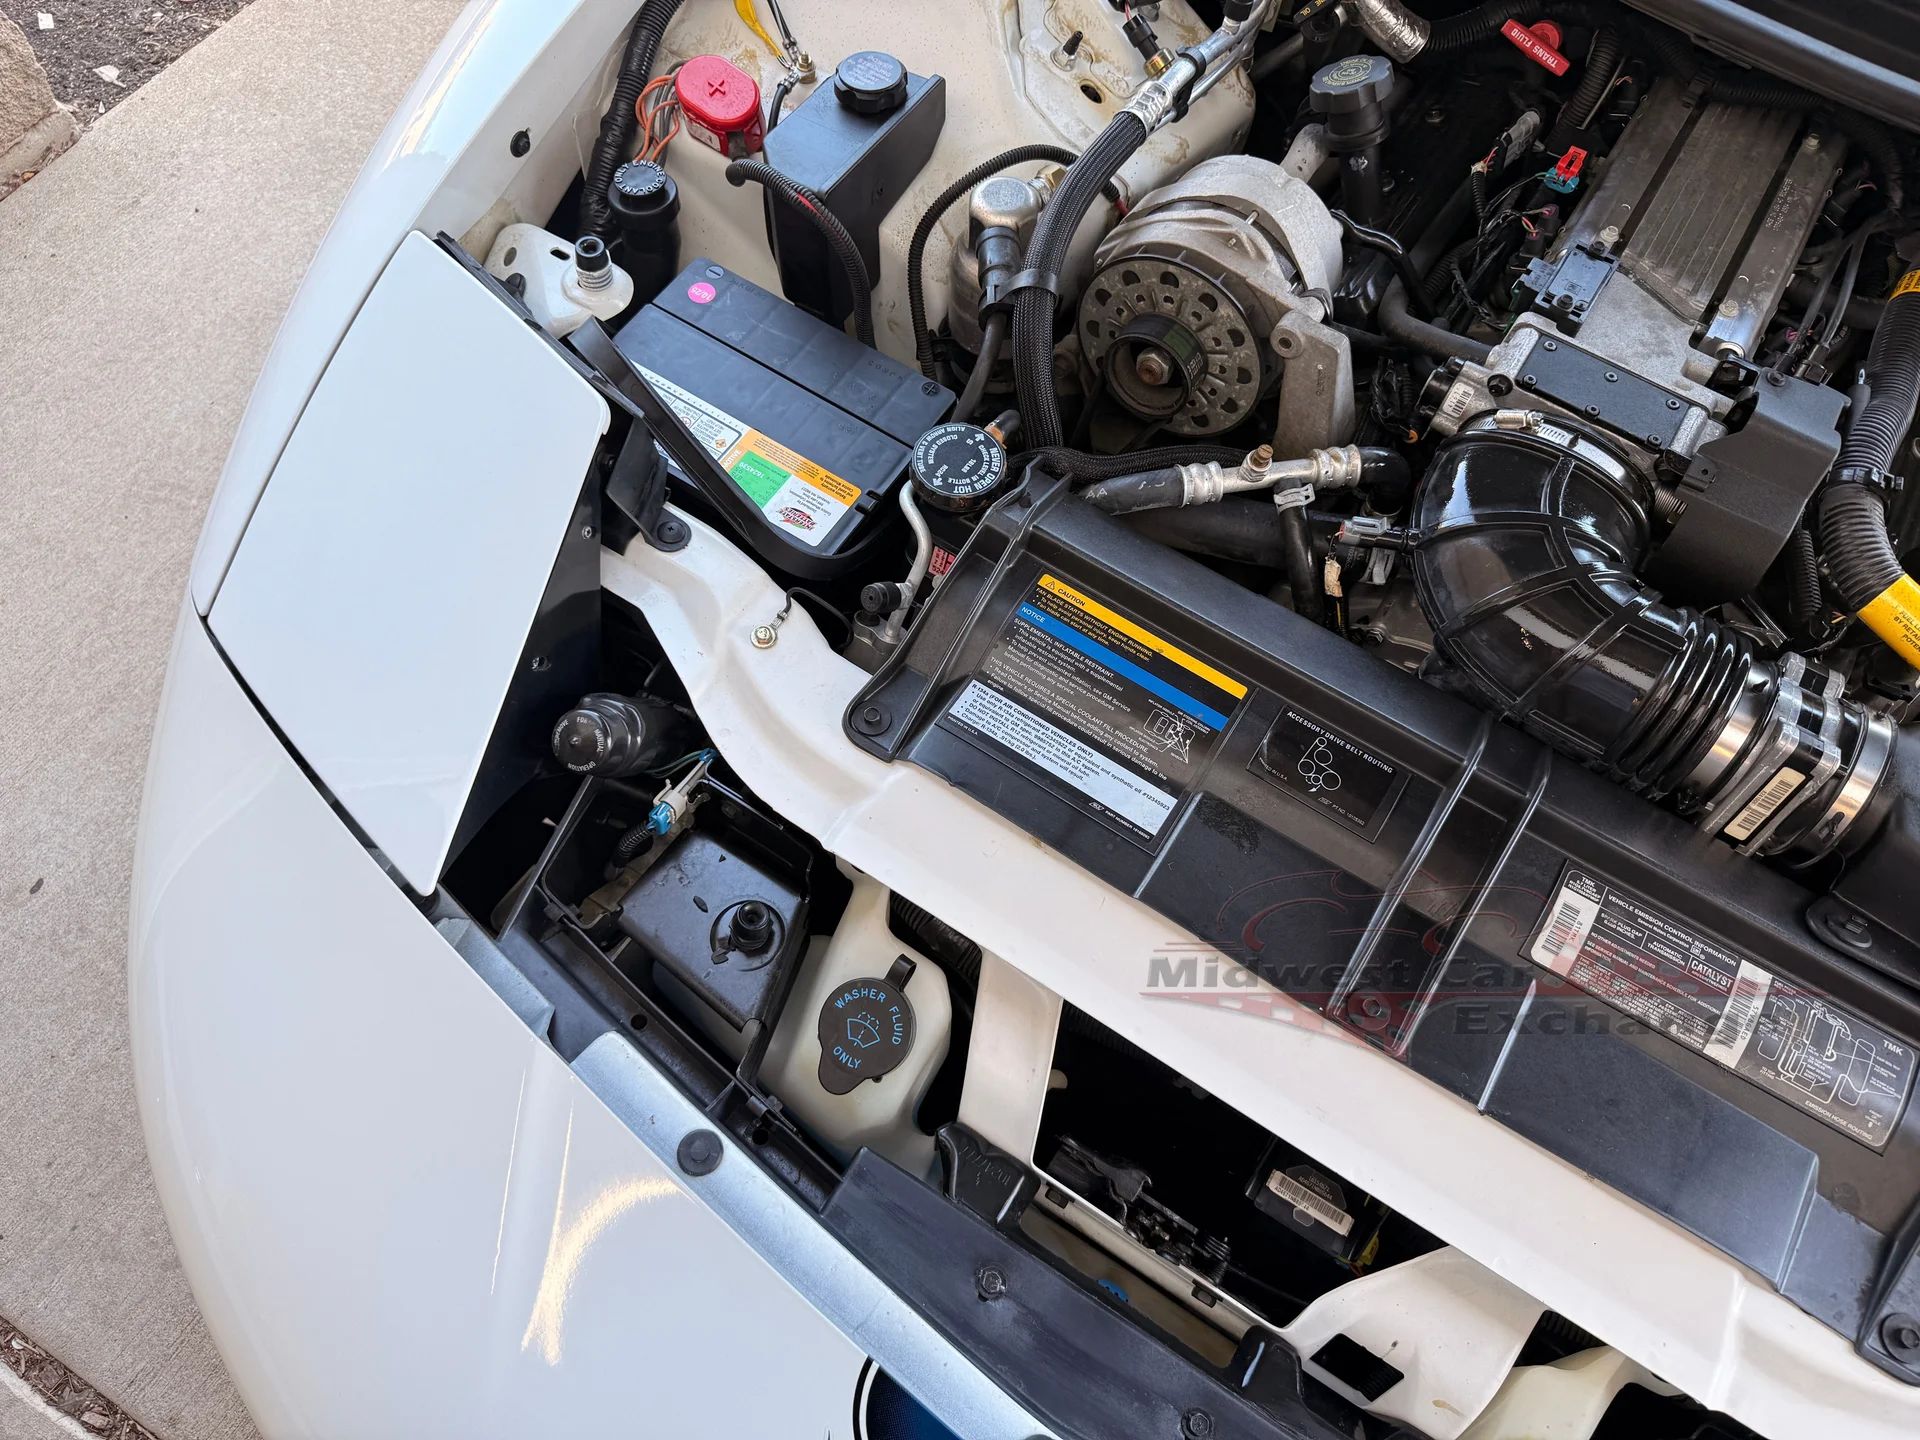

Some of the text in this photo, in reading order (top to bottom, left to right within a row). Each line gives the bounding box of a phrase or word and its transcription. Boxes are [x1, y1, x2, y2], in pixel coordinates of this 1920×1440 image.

[1511, 28, 1558, 68] TRANS FLUID
[858, 59, 892, 77] STEERING
[868, 56, 894, 70] POWER
[615, 160, 664, 194] ENGINE COOLANT ONLY
[691, 286, 711, 300] 10/25
[917, 446, 925, 458] VENT
[928, 434, 958, 464] CLOSED SYSTEM
[978, 444, 990, 460] CHECK
[989, 448, 1000, 472] NEVER
[738, 461, 765, 478] 1624539
[917, 459, 926, 474] TUBE
[978, 462, 989, 476] LEVEL
[820, 482, 847, 499] Return warranty
[823, 478, 839, 489] batteries
[824, 474, 854, 492] Costco Wholesale
[974, 473, 995, 490] OPEN
[776, 508, 814, 531] INTERSTATE
[783, 506, 815, 526] BATTERIES
[1056, 587, 1086, 606] CAUTION
[1021, 606, 1045, 623] NOTICE
[1035, 587, 1154, 657] FAN BLADE STARTS WITHOUT ENGINE RUNNING.
[1036, 601, 1047, 610] Fan
[1046, 607, 1061, 618] blade
[1060, 615, 1070, 623] can
[1069, 620, 1082, 630] start
[1087, 631, 1097, 639] any
[1096, 636, 1110, 646] time.
[1894, 616, 1903, 625] BY
[1899, 611, 1915, 625] FUEL
[1045, 600, 1058, 610] help
[1056, 607, 1072, 618] avoid
[1070, 615, 1093, 630] personal
[1091, 627, 1108, 639] injury,
[1106, 635, 1120, 646] keep
[1119, 643, 1136, 655] hands
[1135, 651, 1150, 663] clear.
[1013, 618, 1114, 678] SUPPLEMENTAL INFLATABLE RESTRAINT.
[1017, 628, 1029, 637] This
[1028, 634, 1047, 647] vehicle
[1051, 647, 1075, 663] equipped
[1073, 660, 1086, 670] with
[1089, 669, 1123, 692] supplemental
[1006, 645, 1115, 711] Manual for diagnostic and service procedures
[1016, 643, 1029, 653] help
[1027, 649, 1047, 663] prevent
[1046, 660, 1072, 678] unwanted
[1070, 674, 1093, 690] inflation,
[1092, 687, 1102, 696] see
[1101, 692, 1112, 701] GM
[1111, 698, 1131, 713] Service
[989, 656, 1003, 667] THIS
[1001, 663, 1024, 679] VEHICLE
[1023, 676, 1051, 695] REQUIRES
[1054, 695, 1078, 711] SPECIAL
[1076, 707, 1103, 726] COOLANT
[1102, 723, 1115, 733] FILL
[1114, 730, 1150, 754] PROCEDURE.
[971, 683, 1094, 758] R-134a (FOR AIR CONDITIONED VEHICLES ONLY)
[594, 729, 604, 756] MANUAL
[1286, 710, 1393, 774] ACCESSORY DRIVE BELT ROUTING
[568, 761, 596, 771] OPERATION
[1580, 876, 1595, 887] TMK
[1607, 894, 1634, 912] VEHICLE
[1634, 908, 1663, 927] EMISSION
[1663, 924, 1693, 943] CONTROL
[1693, 940, 1736, 967] INFORMATION
[1637, 917, 1689, 948] General Motors Corporation
[1646, 942, 1685, 966] TRANSMISSION
[1652, 940, 1682, 959] AUTOMATIC
[1690, 959, 1733, 989] CATALYST
[833, 988, 903, 1069] WASHER FLUID ONLY
[1881, 1039, 1903, 1056] TMK
[1804, 1099, 1872, 1140] EMISSION HOSE ROUTING
